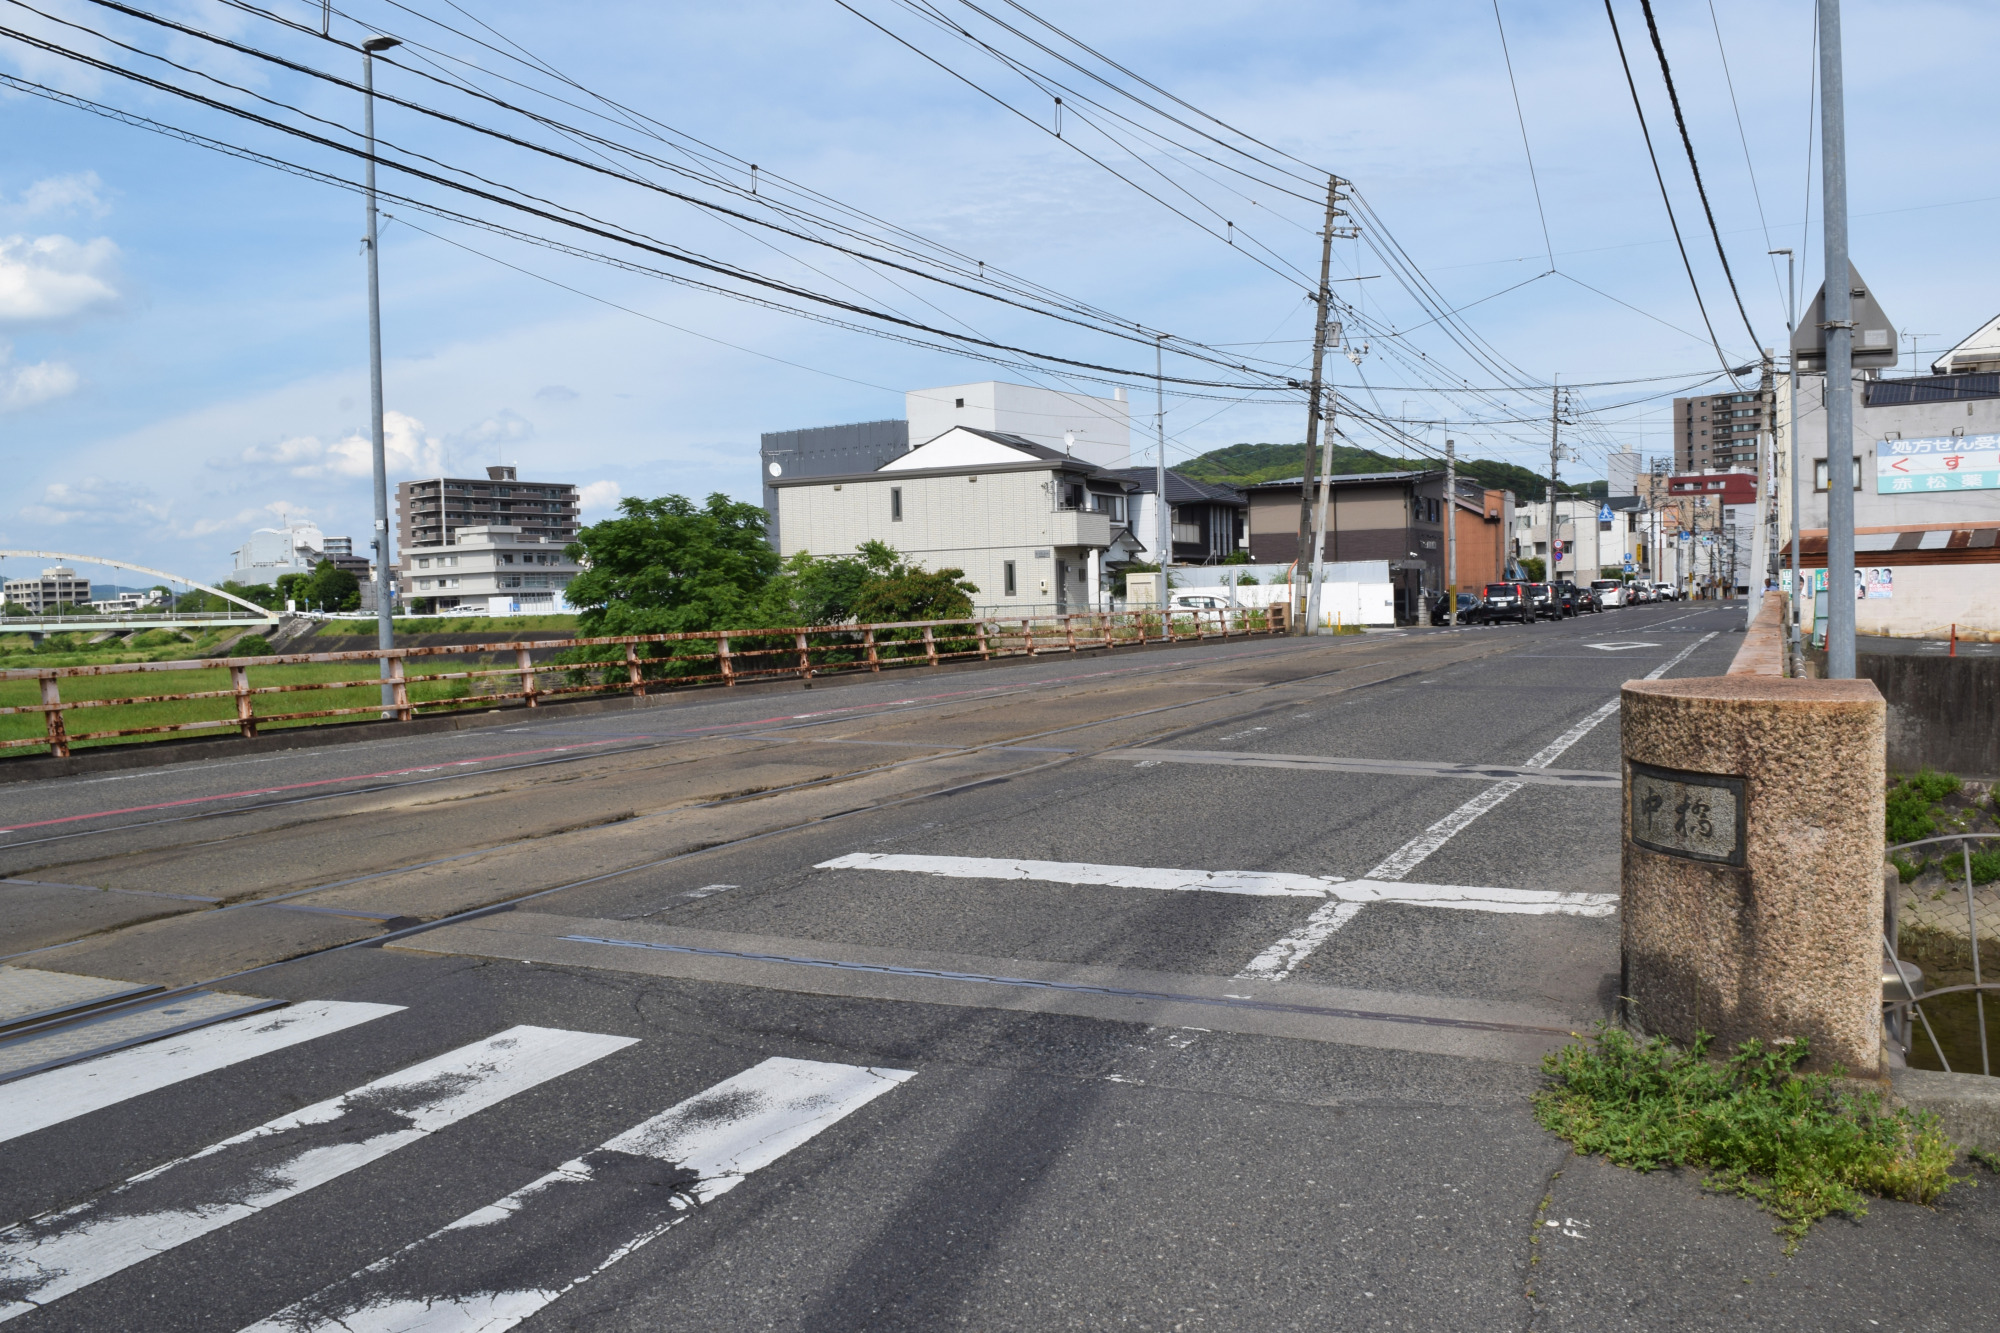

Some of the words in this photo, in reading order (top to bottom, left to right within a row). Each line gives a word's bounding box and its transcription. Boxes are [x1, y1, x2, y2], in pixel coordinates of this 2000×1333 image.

[1892, 455, 2000, 473] くす
[1892, 473, 2000, 491] 赤松薬
[1640, 785, 1713, 838] 中橋
